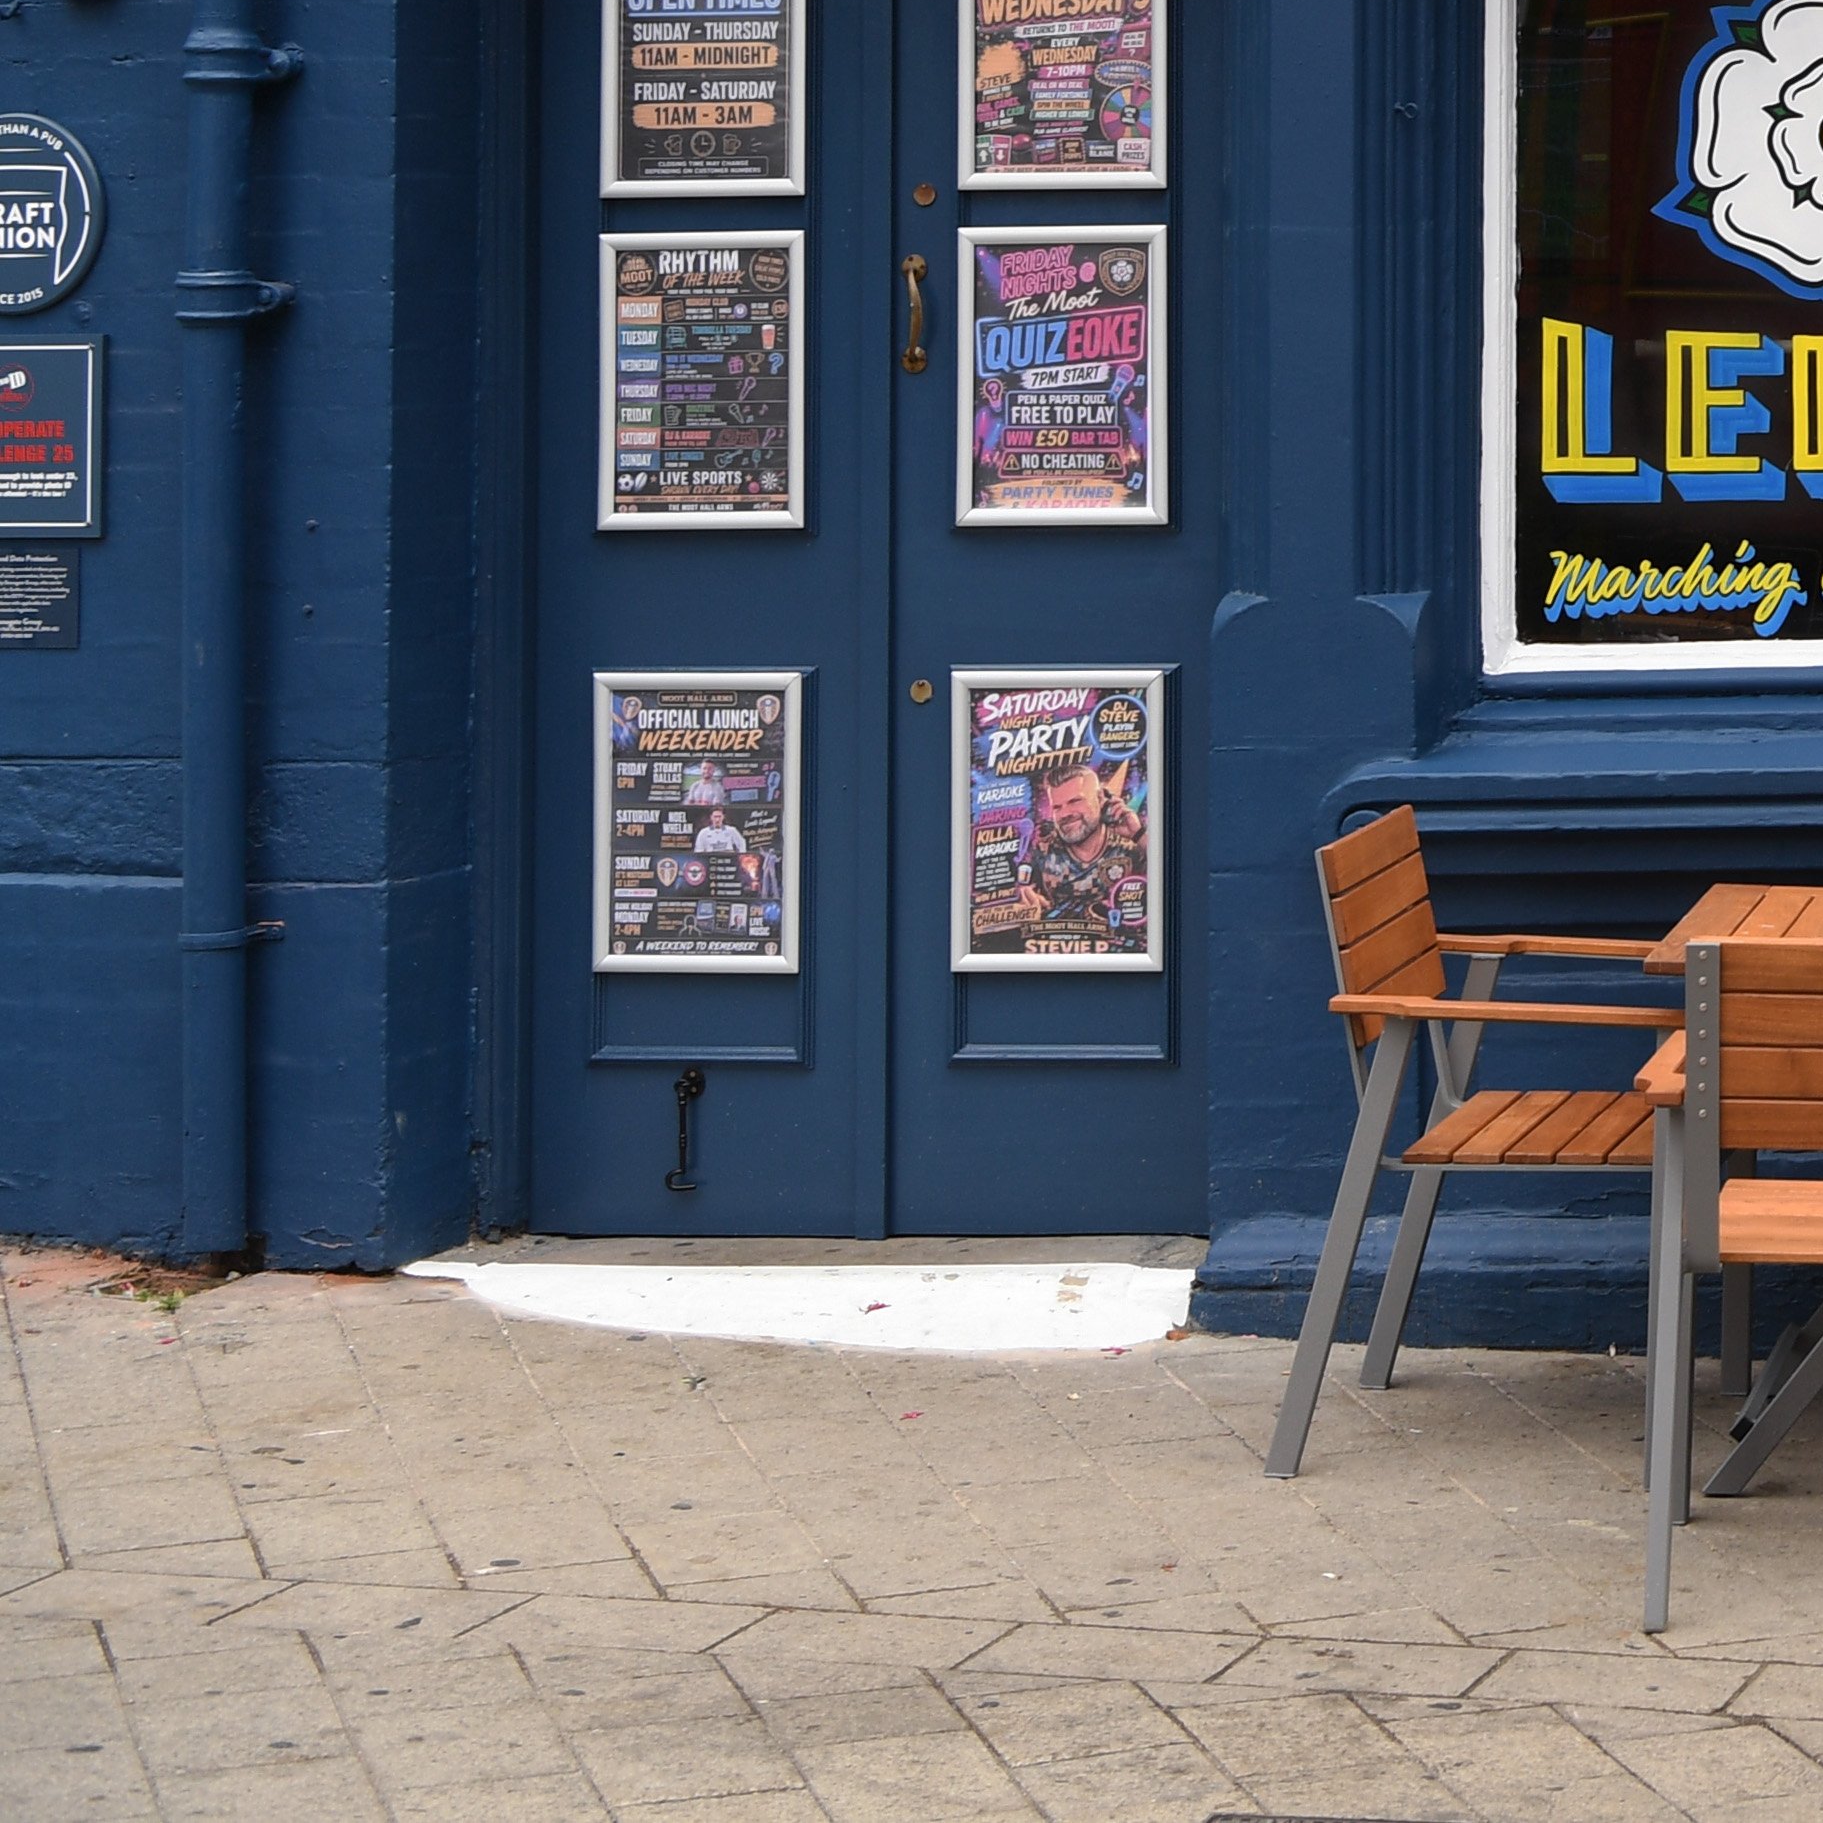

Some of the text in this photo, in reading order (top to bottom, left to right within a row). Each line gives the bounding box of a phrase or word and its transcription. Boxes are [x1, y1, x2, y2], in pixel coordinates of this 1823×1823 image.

[633, 21, 777, 41] SUNDAY THURSDAY
[1023, 25, 1056, 35] RETURNS
[1069, 23, 1084, 31] THE
[1051, 38, 1080, 48] EVERY
[641, 46, 771, 66] 11AM MIDNIGHT
[1032, 46, 1098, 65] WEDNESDAY
[1047, 65, 1086, 77] 7-10PM
[980, 74, 1011, 88] STEVE
[634, 81, 776, 101] FRIDAY SATURDAY
[655, 106, 752, 125] 11AM 3AM
[30, 127, 38, 138] A
[40, 131, 63, 150] PUB
[659, 250, 739, 274] RHYTHM
[1000, 246, 1074, 277] FRIDAY
[663, 270, 745, 288] OF THE WEEK
[1000, 266, 1077, 300] NIGHTS
[17, 287, 43, 304] 2015
[1005, 287, 1103, 321] The Moot
[621, 303, 659, 318] MONDAY
[621, 331, 659, 345] TUESDAY
[985, 313, 1139, 372] QUIZEOKE
[1031, 366, 1099, 386] 7PM START
[621, 384, 659, 398] THURSDAY
[1018, 395, 1106, 404] PEN & PAPER QUIZ
[621, 408, 653, 422] FRIDAY
[1012, 406, 1115, 424] FREE TO PLAY
[620, 432, 657, 445] SATURDAY
[1006, 430, 1118, 447] WIN £50 BAR TAB
[53, 445, 74, 463] 25
[620, 454, 652, 467] SUNDAY
[1021, 454, 1105, 469] NO CHEATING
[659, 471, 742, 485] LIVE SPORTS
[1001, 486, 1113, 499] PARTY TUNES
[1545, 539, 1807, 638] Marching
[980, 689, 1091, 723] SATURDAY
[1113, 701, 1128, 711] DJ
[638, 709, 759, 729] OFFICIAL LAUNCH
[1000, 713, 1054, 730] NIGHT IS
[1099, 709, 1140, 723] STEVE
[638, 729, 764, 751] WEEKENDER
[988, 715, 1091, 768] PARTY
[1099, 731, 1140, 742] BANGERS
[616, 763, 647, 776] FRIDAY
[977, 784, 1026, 804] KARAOKE
[616, 810, 660, 823] SATURDAY
[977, 825, 1015, 843] KILLA
[975, 839, 1020, 859] KARAOKE
[615, 856, 651, 870] SUNDAY
[976, 907, 1038, 927] CHALLENGE?
[636, 941, 759, 951] A WEEKEND TO REMEMBER!
[1024, 940, 1090, 954] STEVIE
